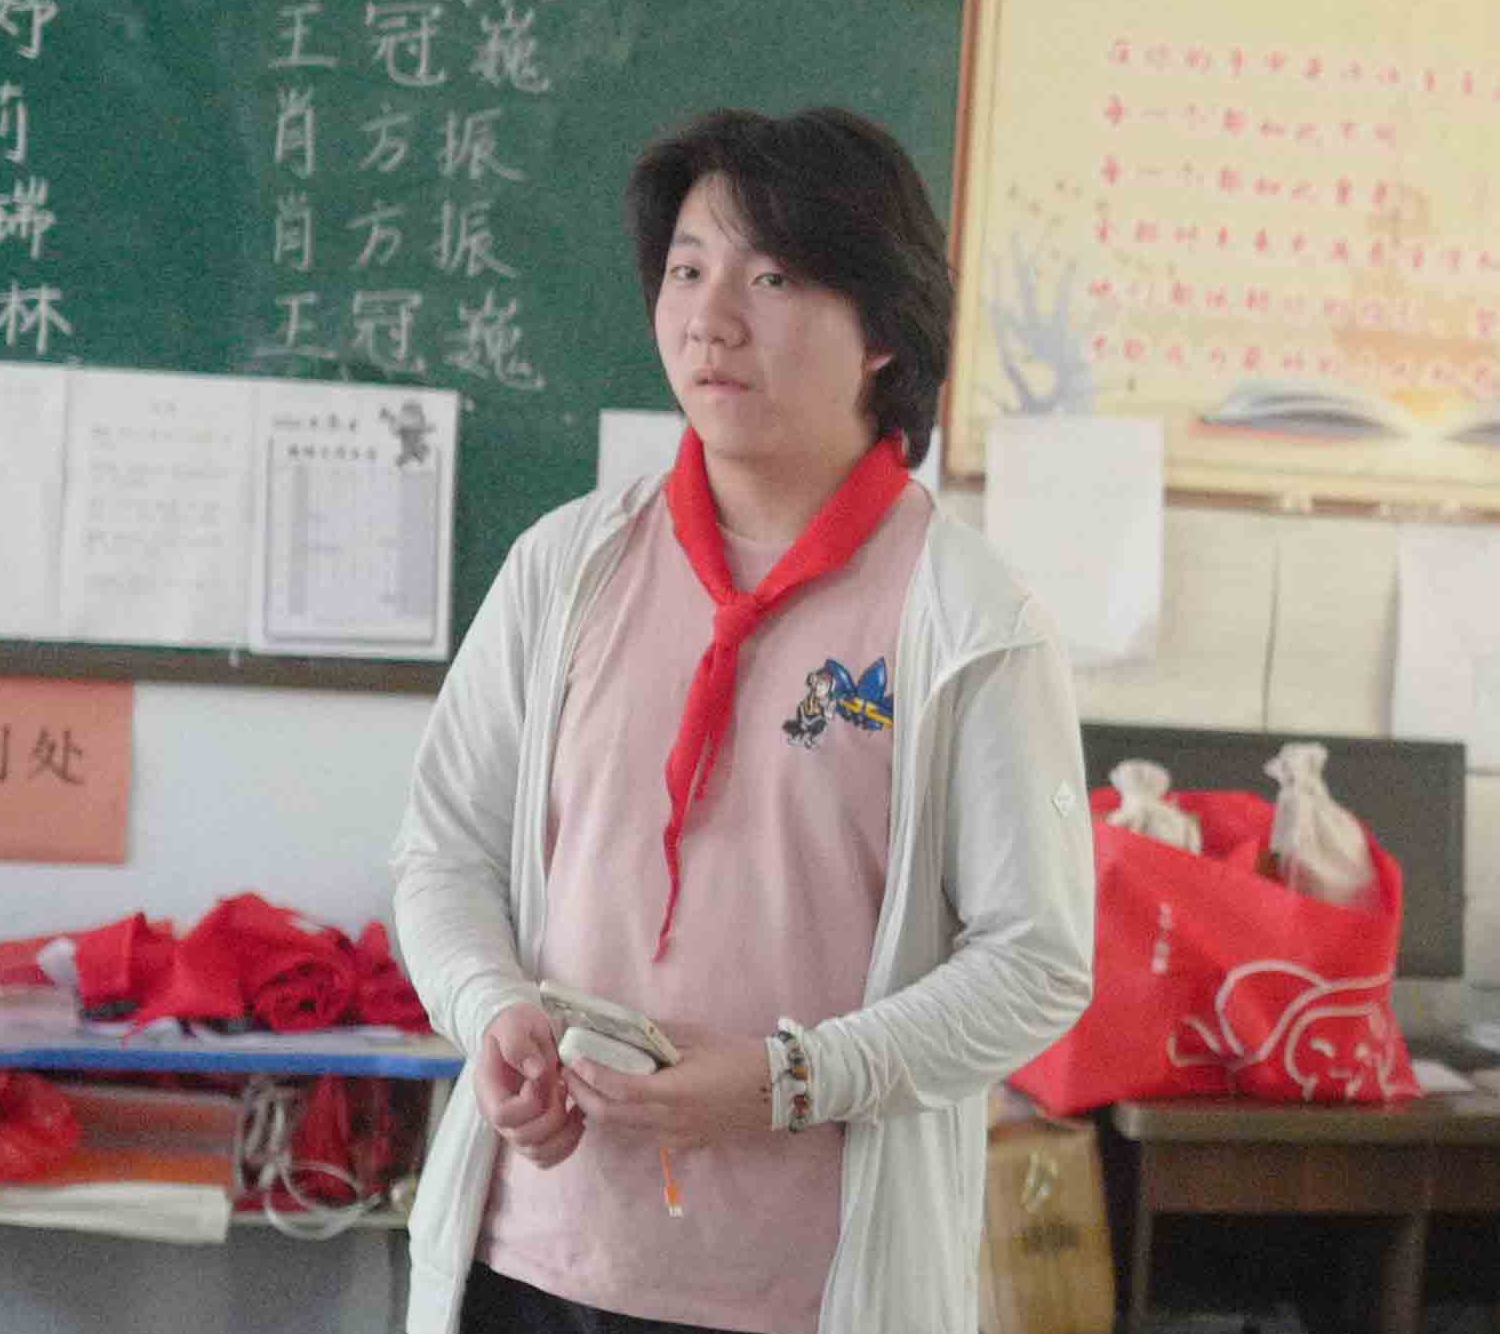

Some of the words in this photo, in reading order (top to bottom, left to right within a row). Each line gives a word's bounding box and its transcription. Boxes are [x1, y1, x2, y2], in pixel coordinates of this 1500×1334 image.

[274, 85, 526, 181] 肖方振
[272, 193, 518, 278] 肖方振
